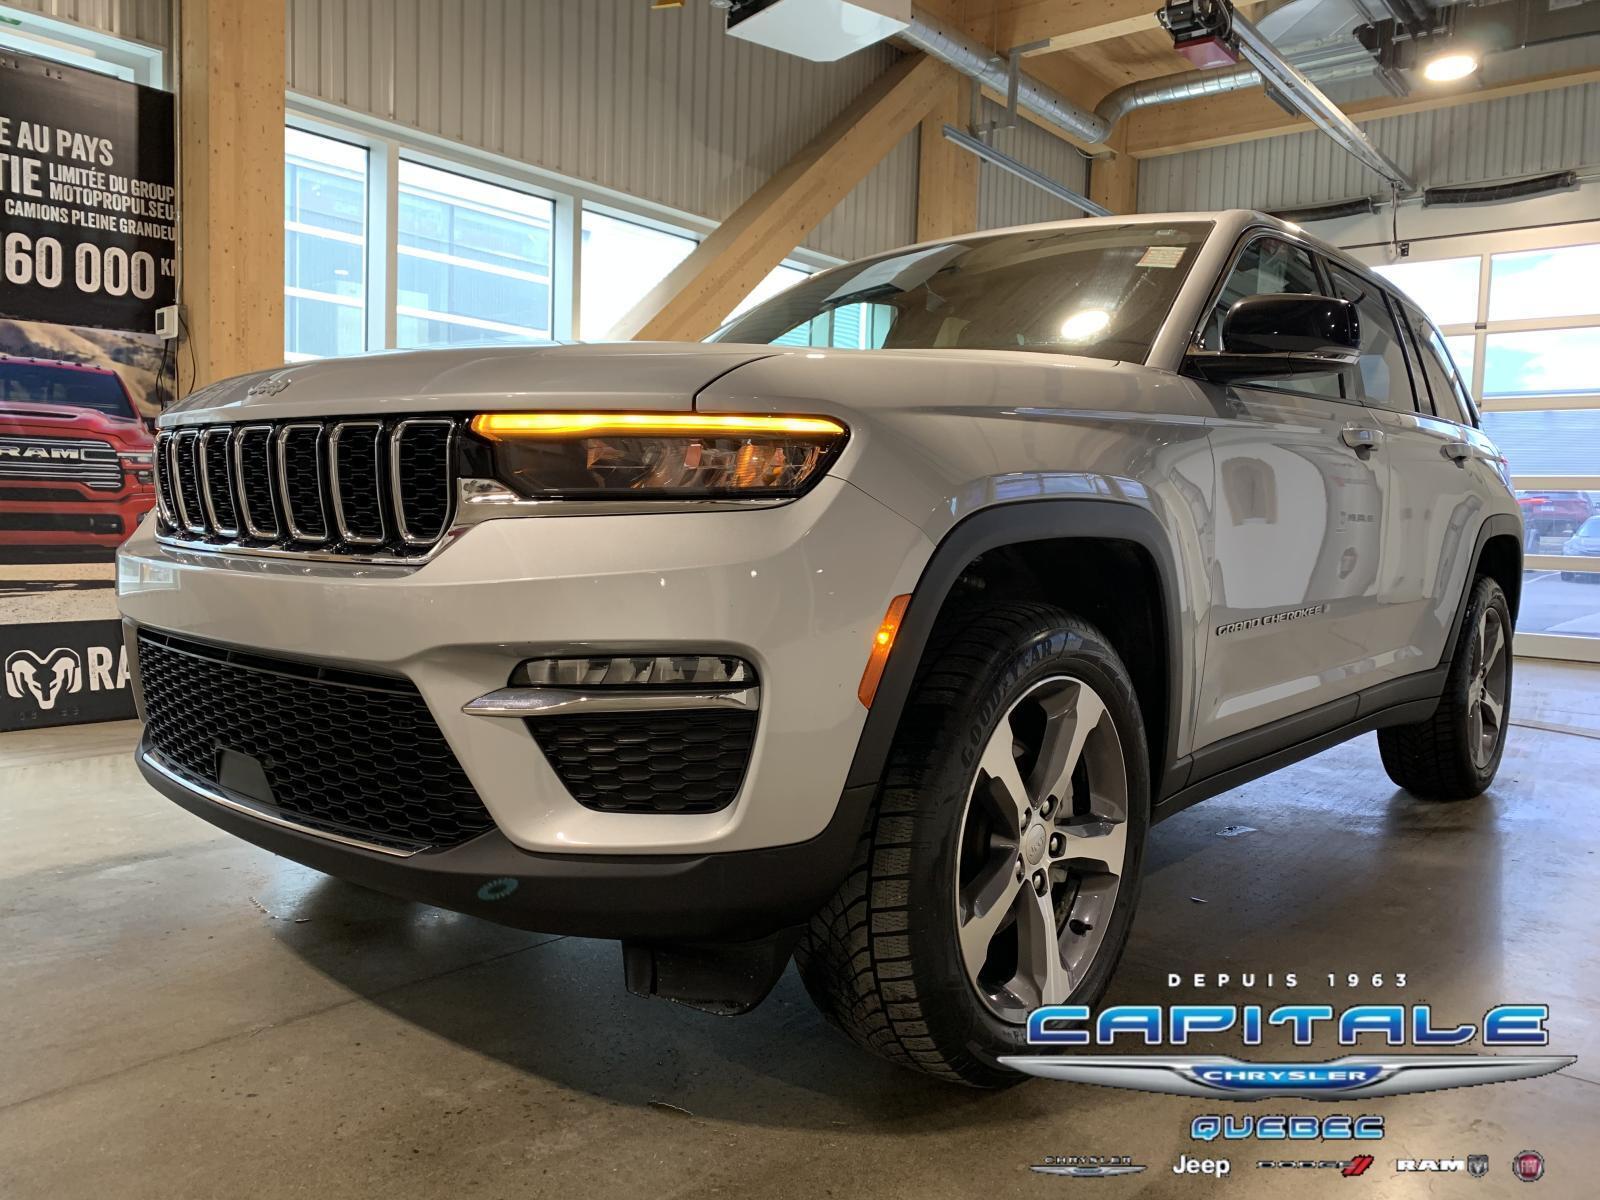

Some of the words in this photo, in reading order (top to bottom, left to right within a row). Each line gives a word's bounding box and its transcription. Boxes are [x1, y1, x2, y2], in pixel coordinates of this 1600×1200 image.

[17, 121, 49, 153] AU
[56, 128, 114, 167] PAYS
[49, 162, 106, 190] LIMITÉE
[109, 174, 128, 194] DU
[5, 198, 69, 224] CAMIONS
[71, 210, 117, 232] PLEINE
[3, 232, 62, 288] 60
[75, 242, 155, 300] 000
[0, 445, 79, 459] RAM
[1215, 618, 1260, 636] GRAND
[1261, 604, 1325, 626] CHEROKEE
